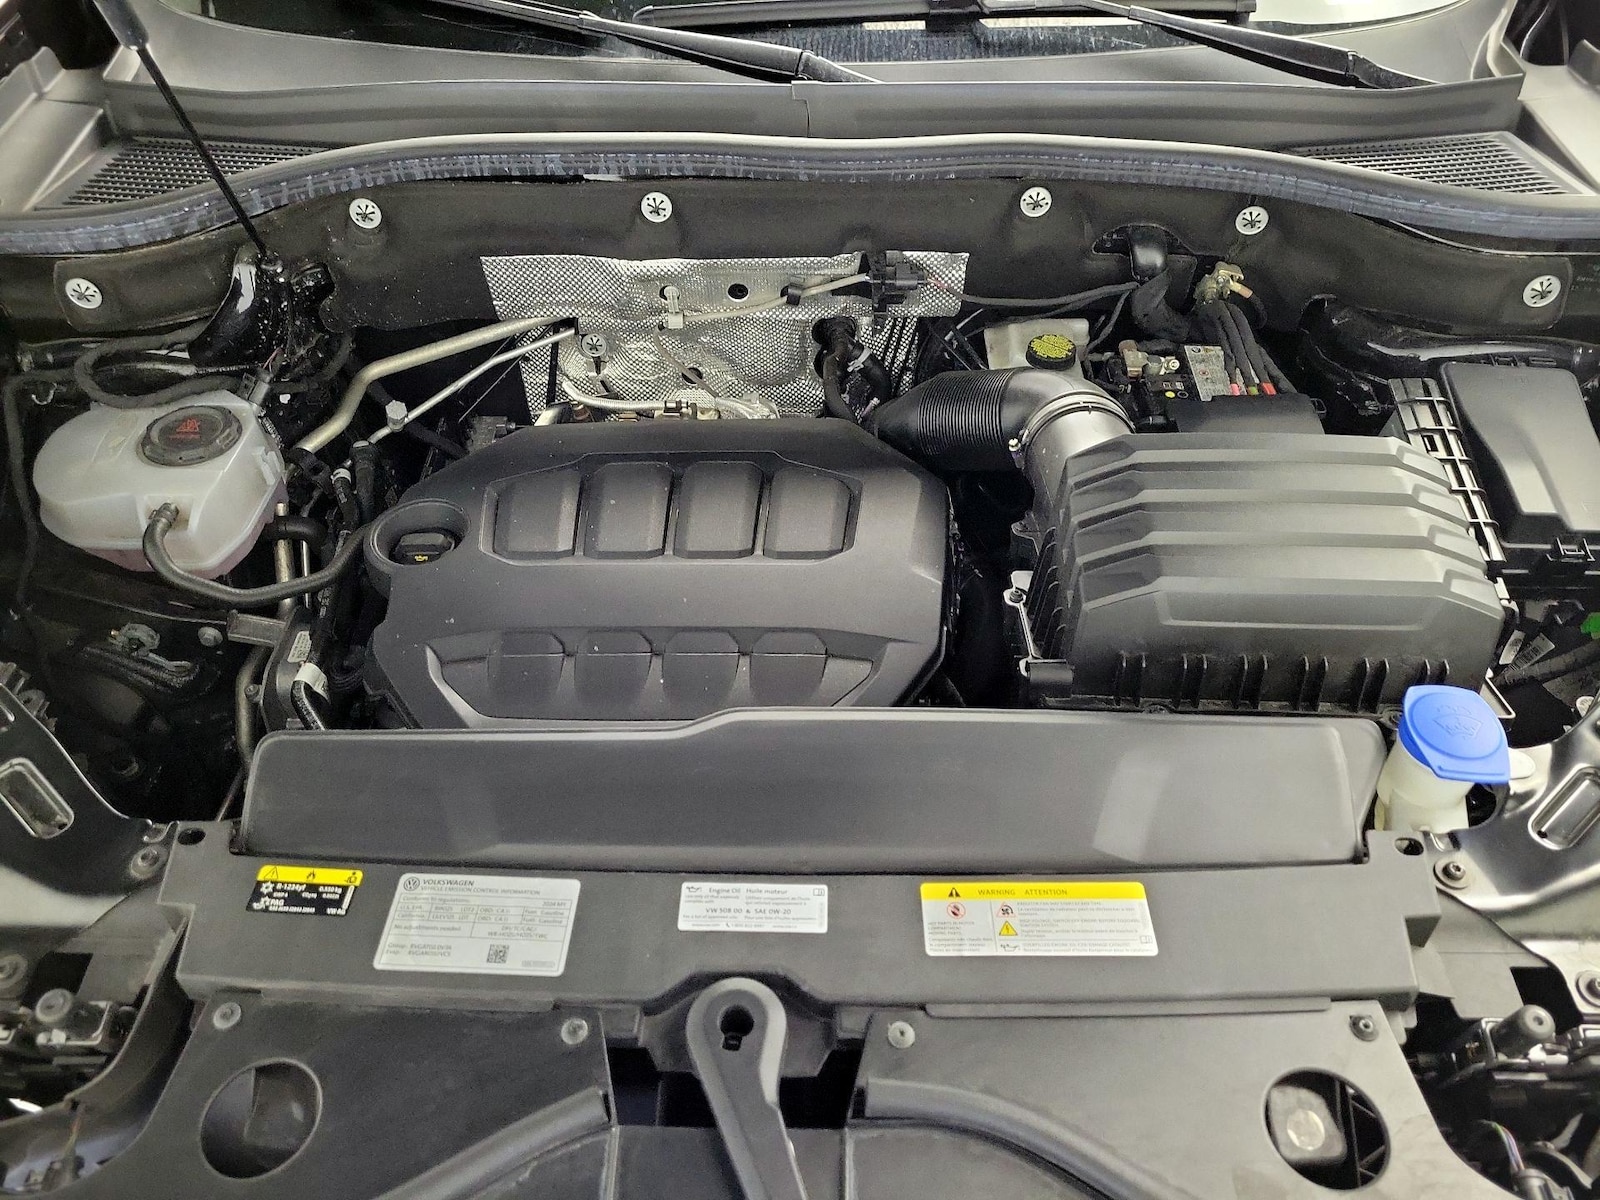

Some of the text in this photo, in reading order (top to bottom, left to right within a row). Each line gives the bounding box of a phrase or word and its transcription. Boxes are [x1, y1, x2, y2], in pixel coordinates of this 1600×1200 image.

[423, 879, 475, 887] VOLKSWAGEN
[709, 887, 730, 895] Engine
[977, 888, 1068, 896] WARNING ATTENTION
